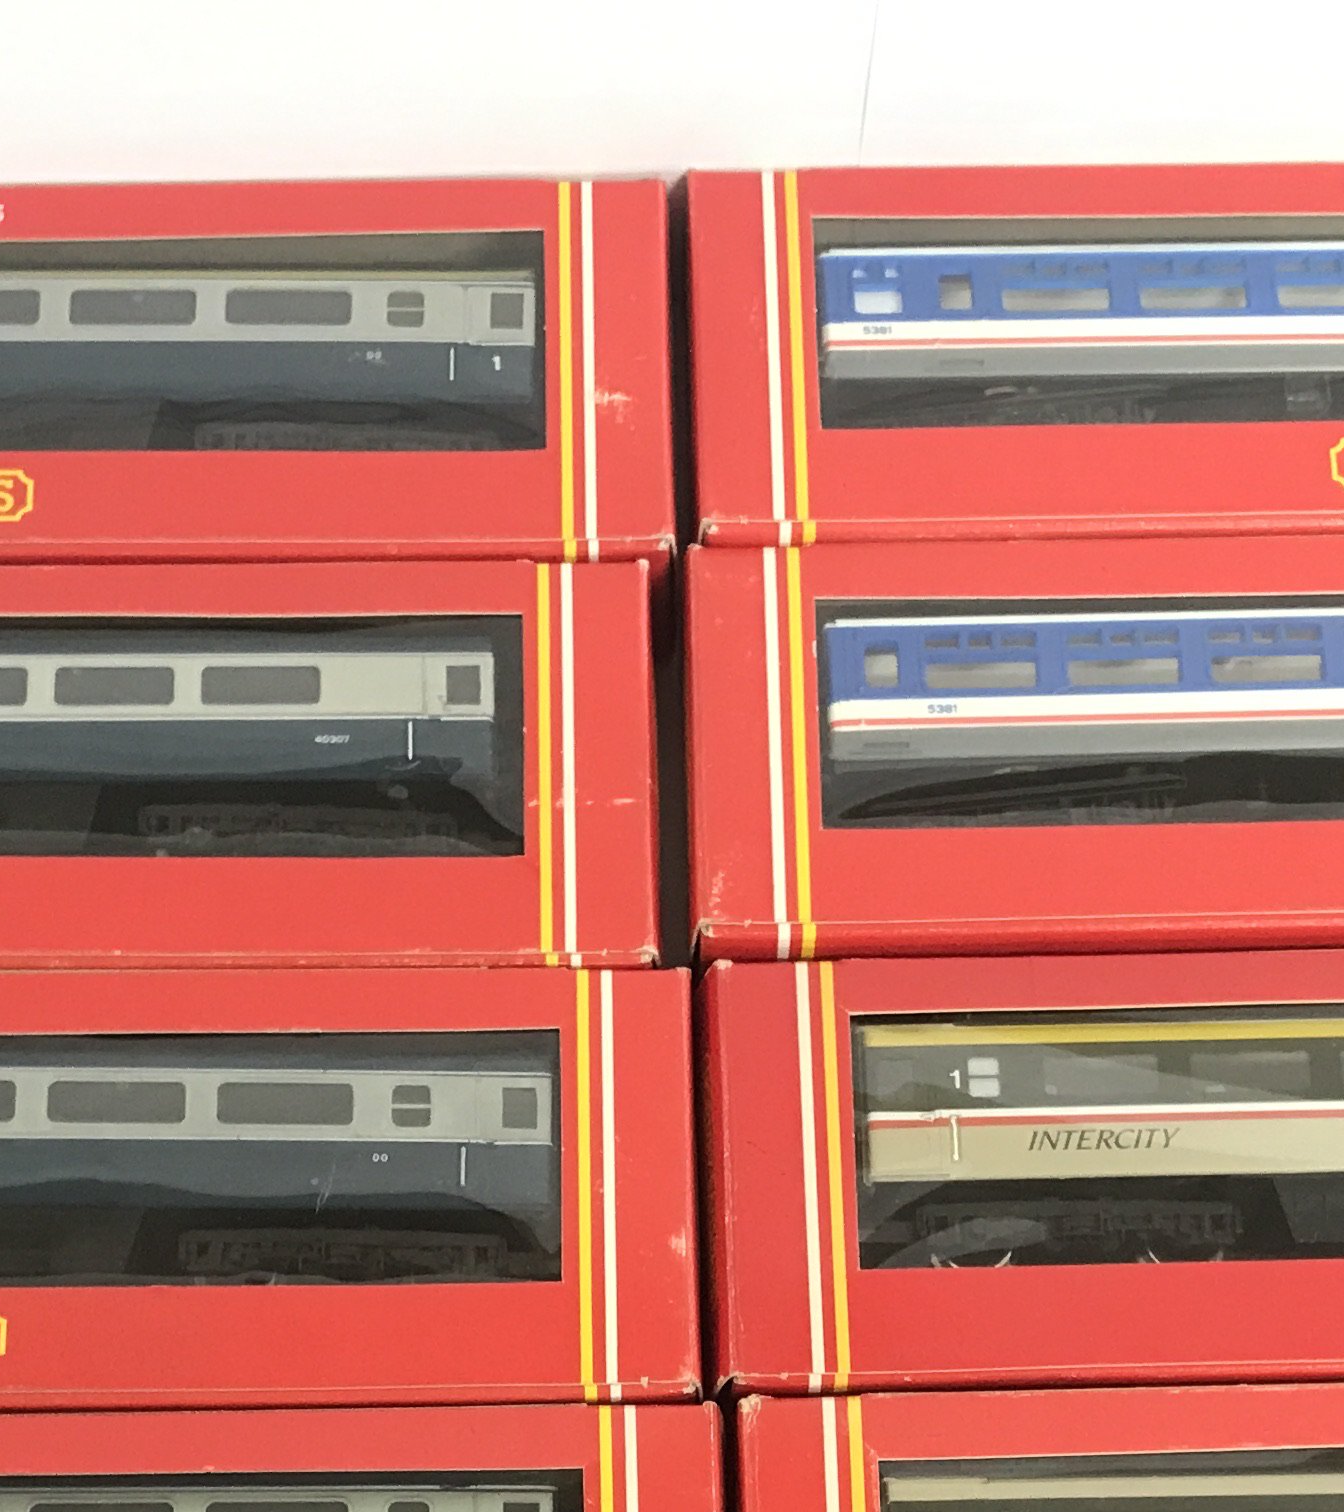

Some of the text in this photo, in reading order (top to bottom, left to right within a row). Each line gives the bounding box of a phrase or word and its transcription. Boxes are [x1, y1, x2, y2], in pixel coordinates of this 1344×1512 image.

[492, 355, 502, 371] 1
[949, 1069, 961, 1089] 1
[1028, 1129, 1180, 1151] INTERCITY
